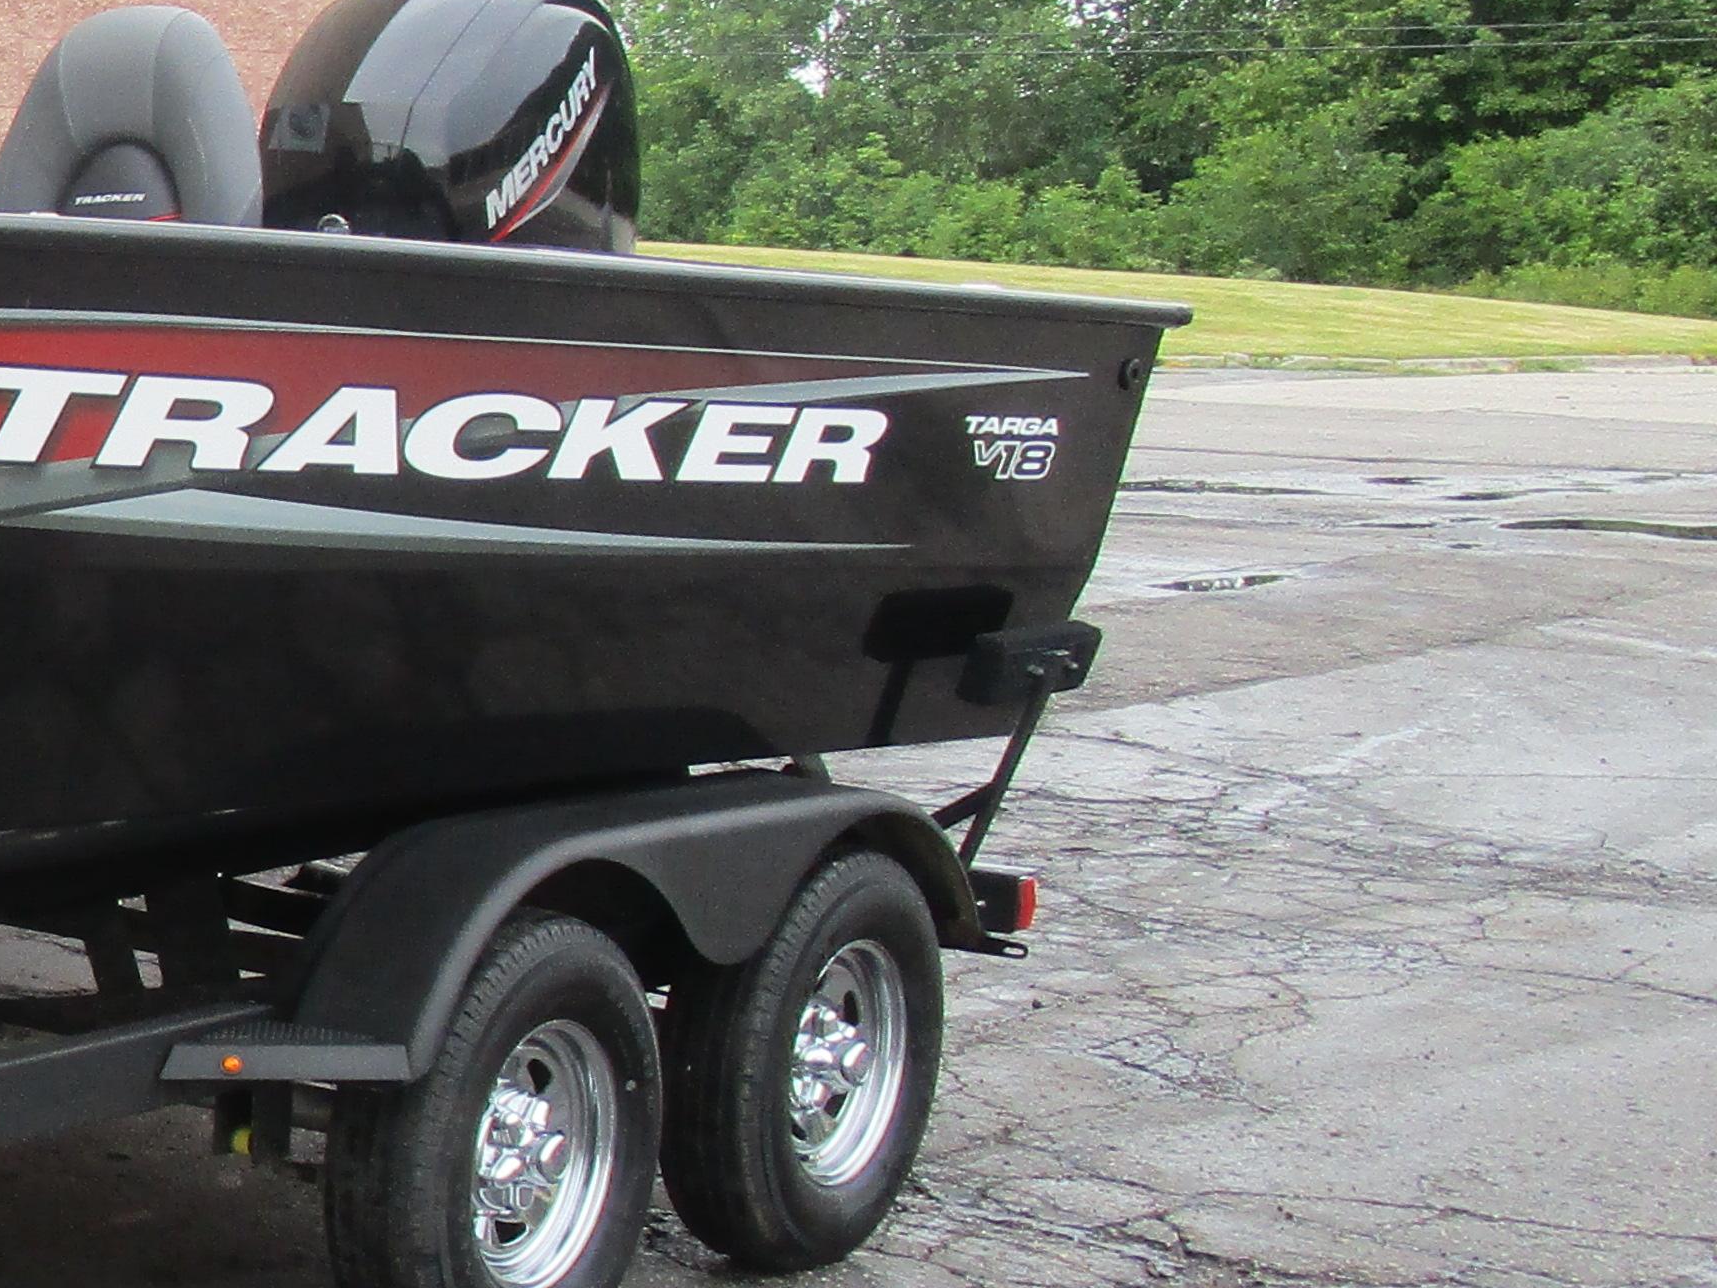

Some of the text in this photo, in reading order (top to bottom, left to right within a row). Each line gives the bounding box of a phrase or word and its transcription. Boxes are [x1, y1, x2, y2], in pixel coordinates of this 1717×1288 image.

[485, 45, 597, 230] MERCURY
[74, 192, 146, 206] TRACKER
[965, 415, 1059, 436] TARGA
[973, 439, 1056, 480] V18
